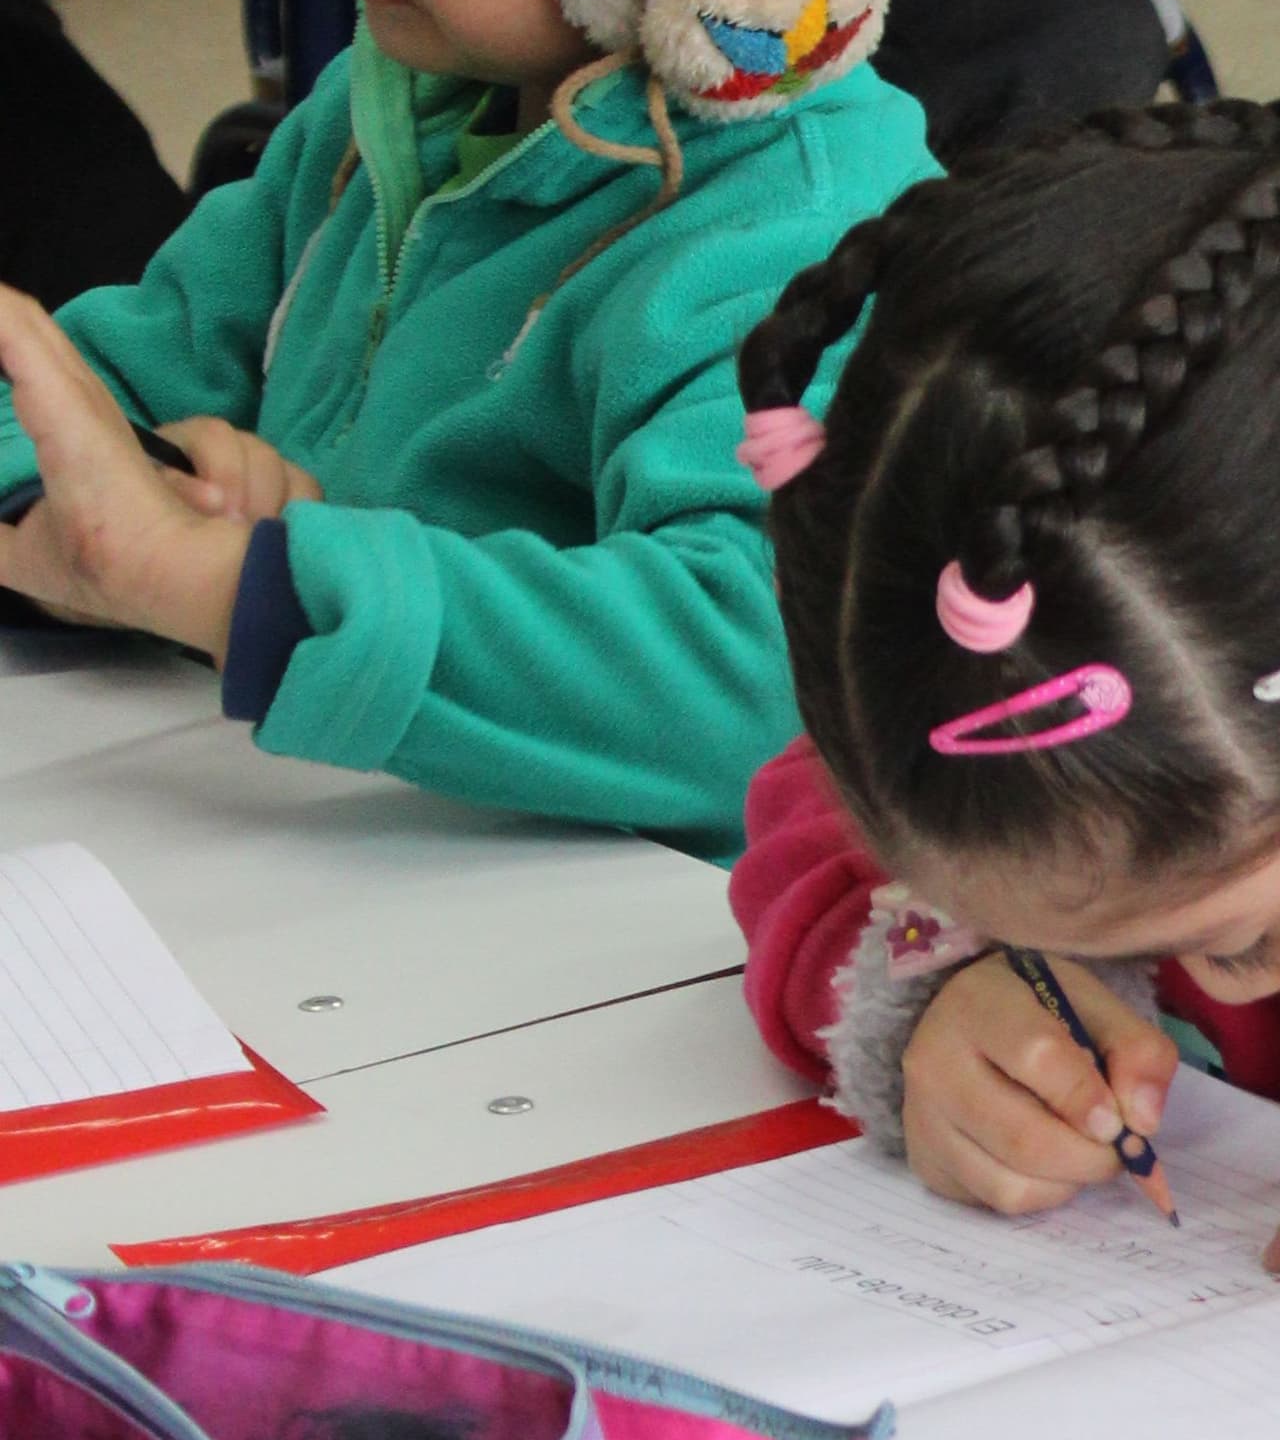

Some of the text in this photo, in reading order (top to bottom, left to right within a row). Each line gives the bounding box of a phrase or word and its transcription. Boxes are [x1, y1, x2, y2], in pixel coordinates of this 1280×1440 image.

[791, 1255, 1017, 1336] El dado de Lulu
